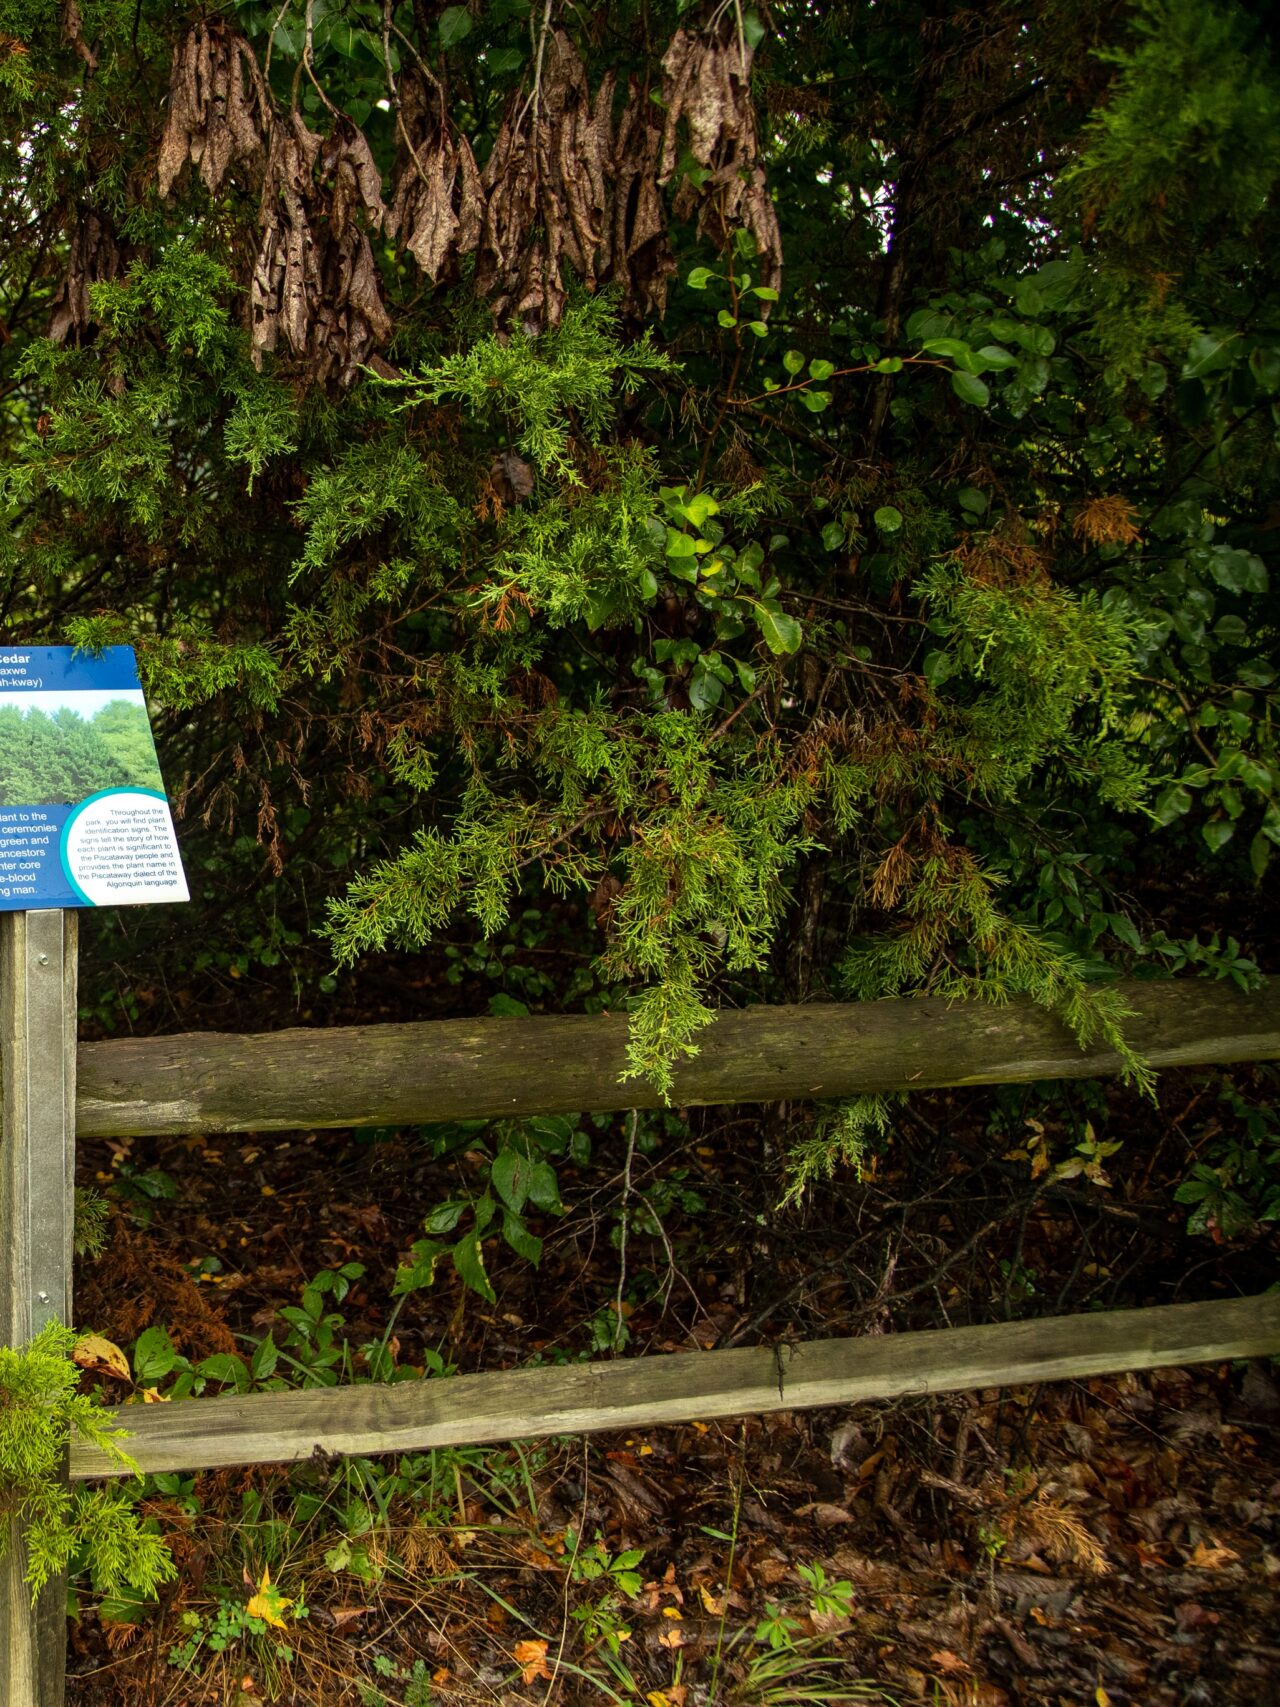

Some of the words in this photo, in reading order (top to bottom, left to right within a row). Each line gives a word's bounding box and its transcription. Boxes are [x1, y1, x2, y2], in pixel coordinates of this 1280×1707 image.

[20, 813, 29, 821] to
[32, 812, 47, 821] the
[110, 809, 151, 817] Throughout
[2, 824, 57, 834] ceremonies
[0, 838, 28, 848] green
[31, 836, 49, 845] and
[80, 837, 99, 845] signs
[127, 835, 144, 843] story
[97, 845, 116, 853] plant
[126, 843, 163, 852] significant
[126, 862, 144, 870] plant
[107, 880, 142, 889] Algonquin
